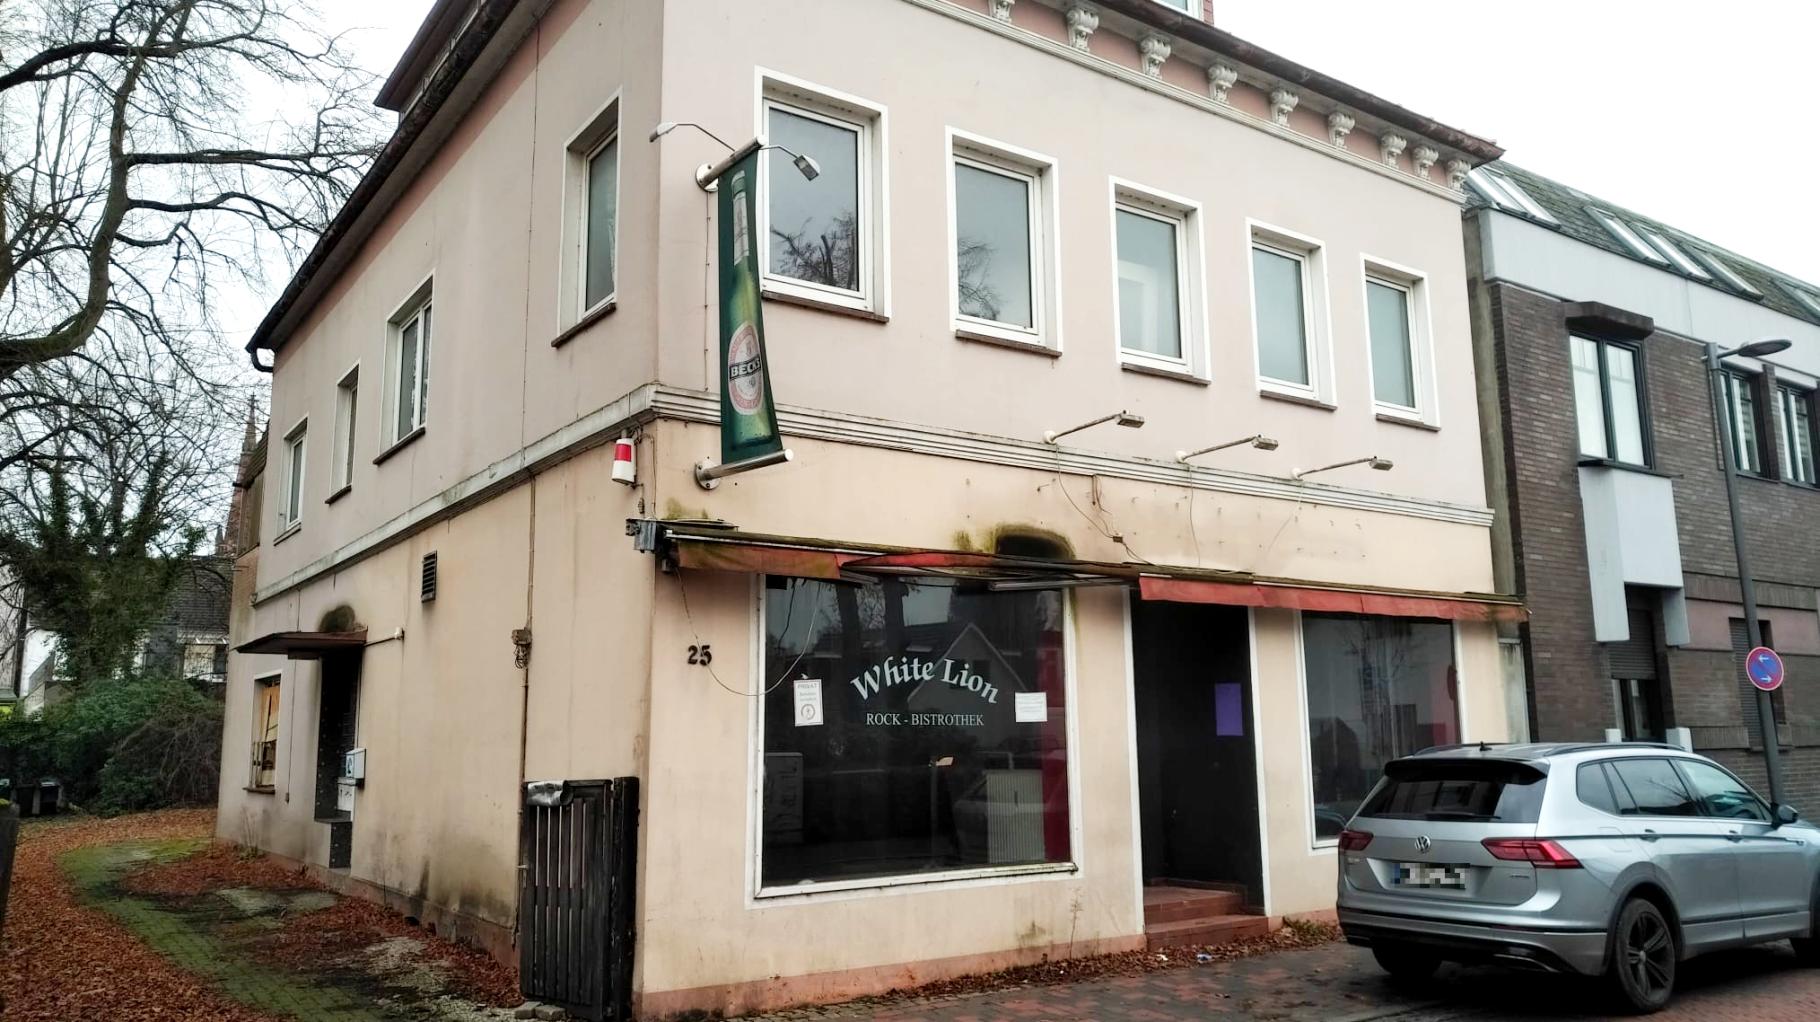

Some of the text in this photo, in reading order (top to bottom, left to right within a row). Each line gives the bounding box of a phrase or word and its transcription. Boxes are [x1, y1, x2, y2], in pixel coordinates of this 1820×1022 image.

[688, 645, 712, 666] 25
[850, 656, 935, 700] White
[941, 659, 999, 704] Lion
[866, 713, 901, 726] ROCK
[911, 713, 984, 726] BISTROTHEK
